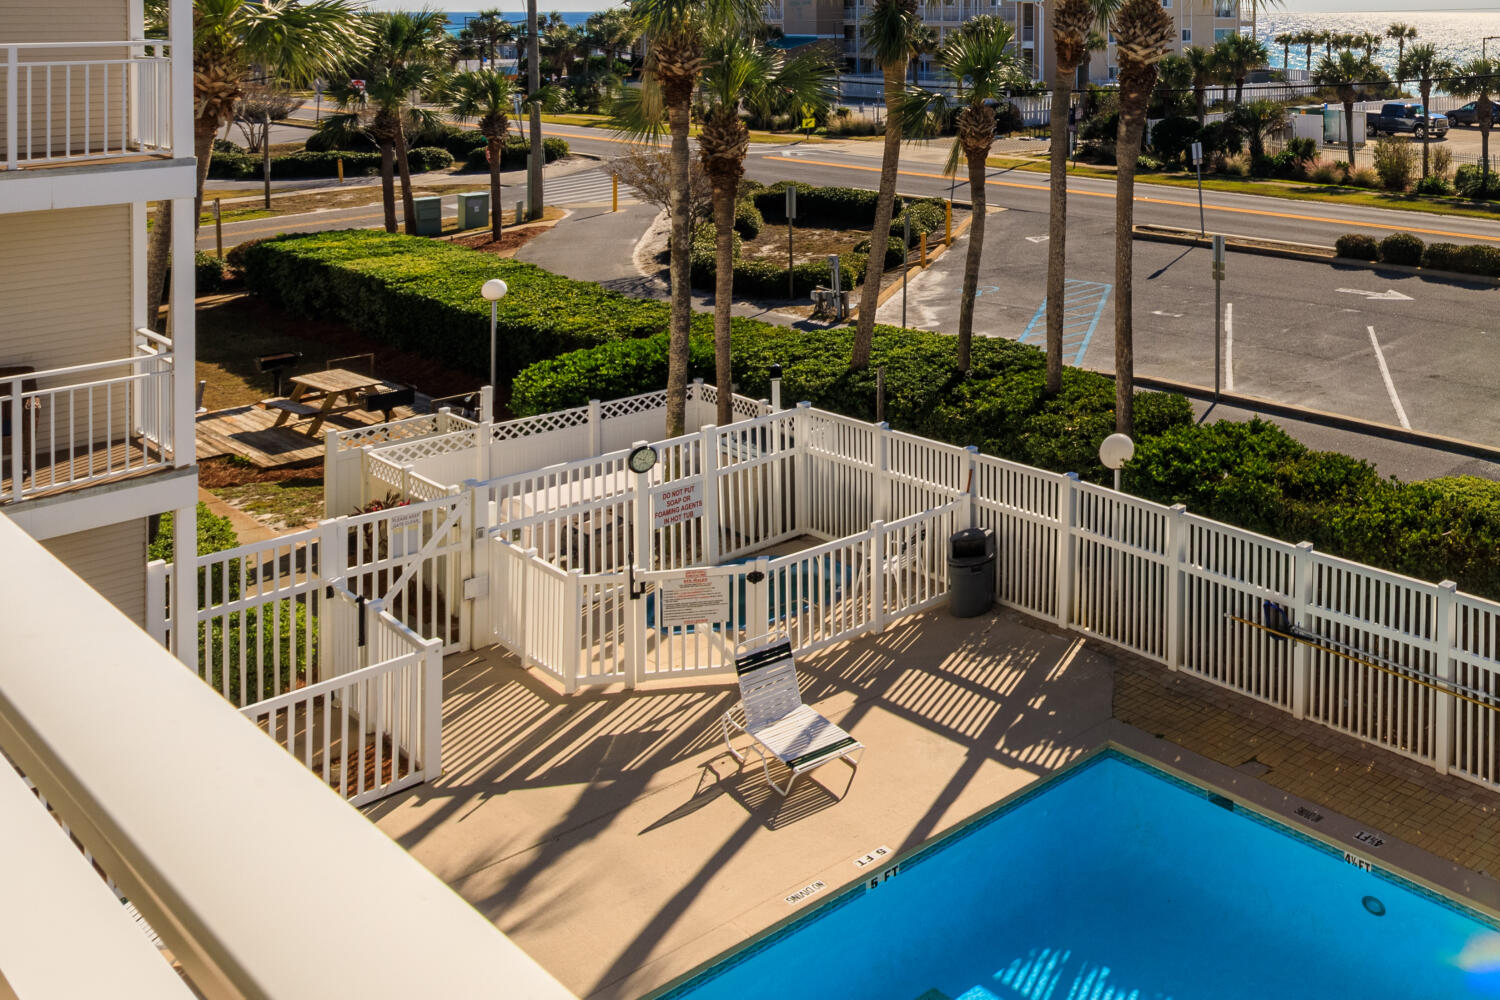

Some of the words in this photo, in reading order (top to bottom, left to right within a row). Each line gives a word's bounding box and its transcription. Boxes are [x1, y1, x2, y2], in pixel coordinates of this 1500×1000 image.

[662, 492, 671, 500] DO
[672, 489, 683, 497] NOT
[684, 485, 695, 494] PUT
[666, 497, 682, 507] SOAP
[682, 495, 691, 503] OR
[655, 506, 680, 519] FOAMING
[681, 500, 703, 511] AGENTS
[671, 514, 682, 522] HOT
[683, 511, 694, 519] TUB
[876, 848, 887, 856] 5
[857, 855, 874, 867] FT
[870, 877, 879, 889] 5
[884, 865, 899, 882] FT
[812, 881, 824, 890] NO
[786, 886, 814, 903] DIVING
